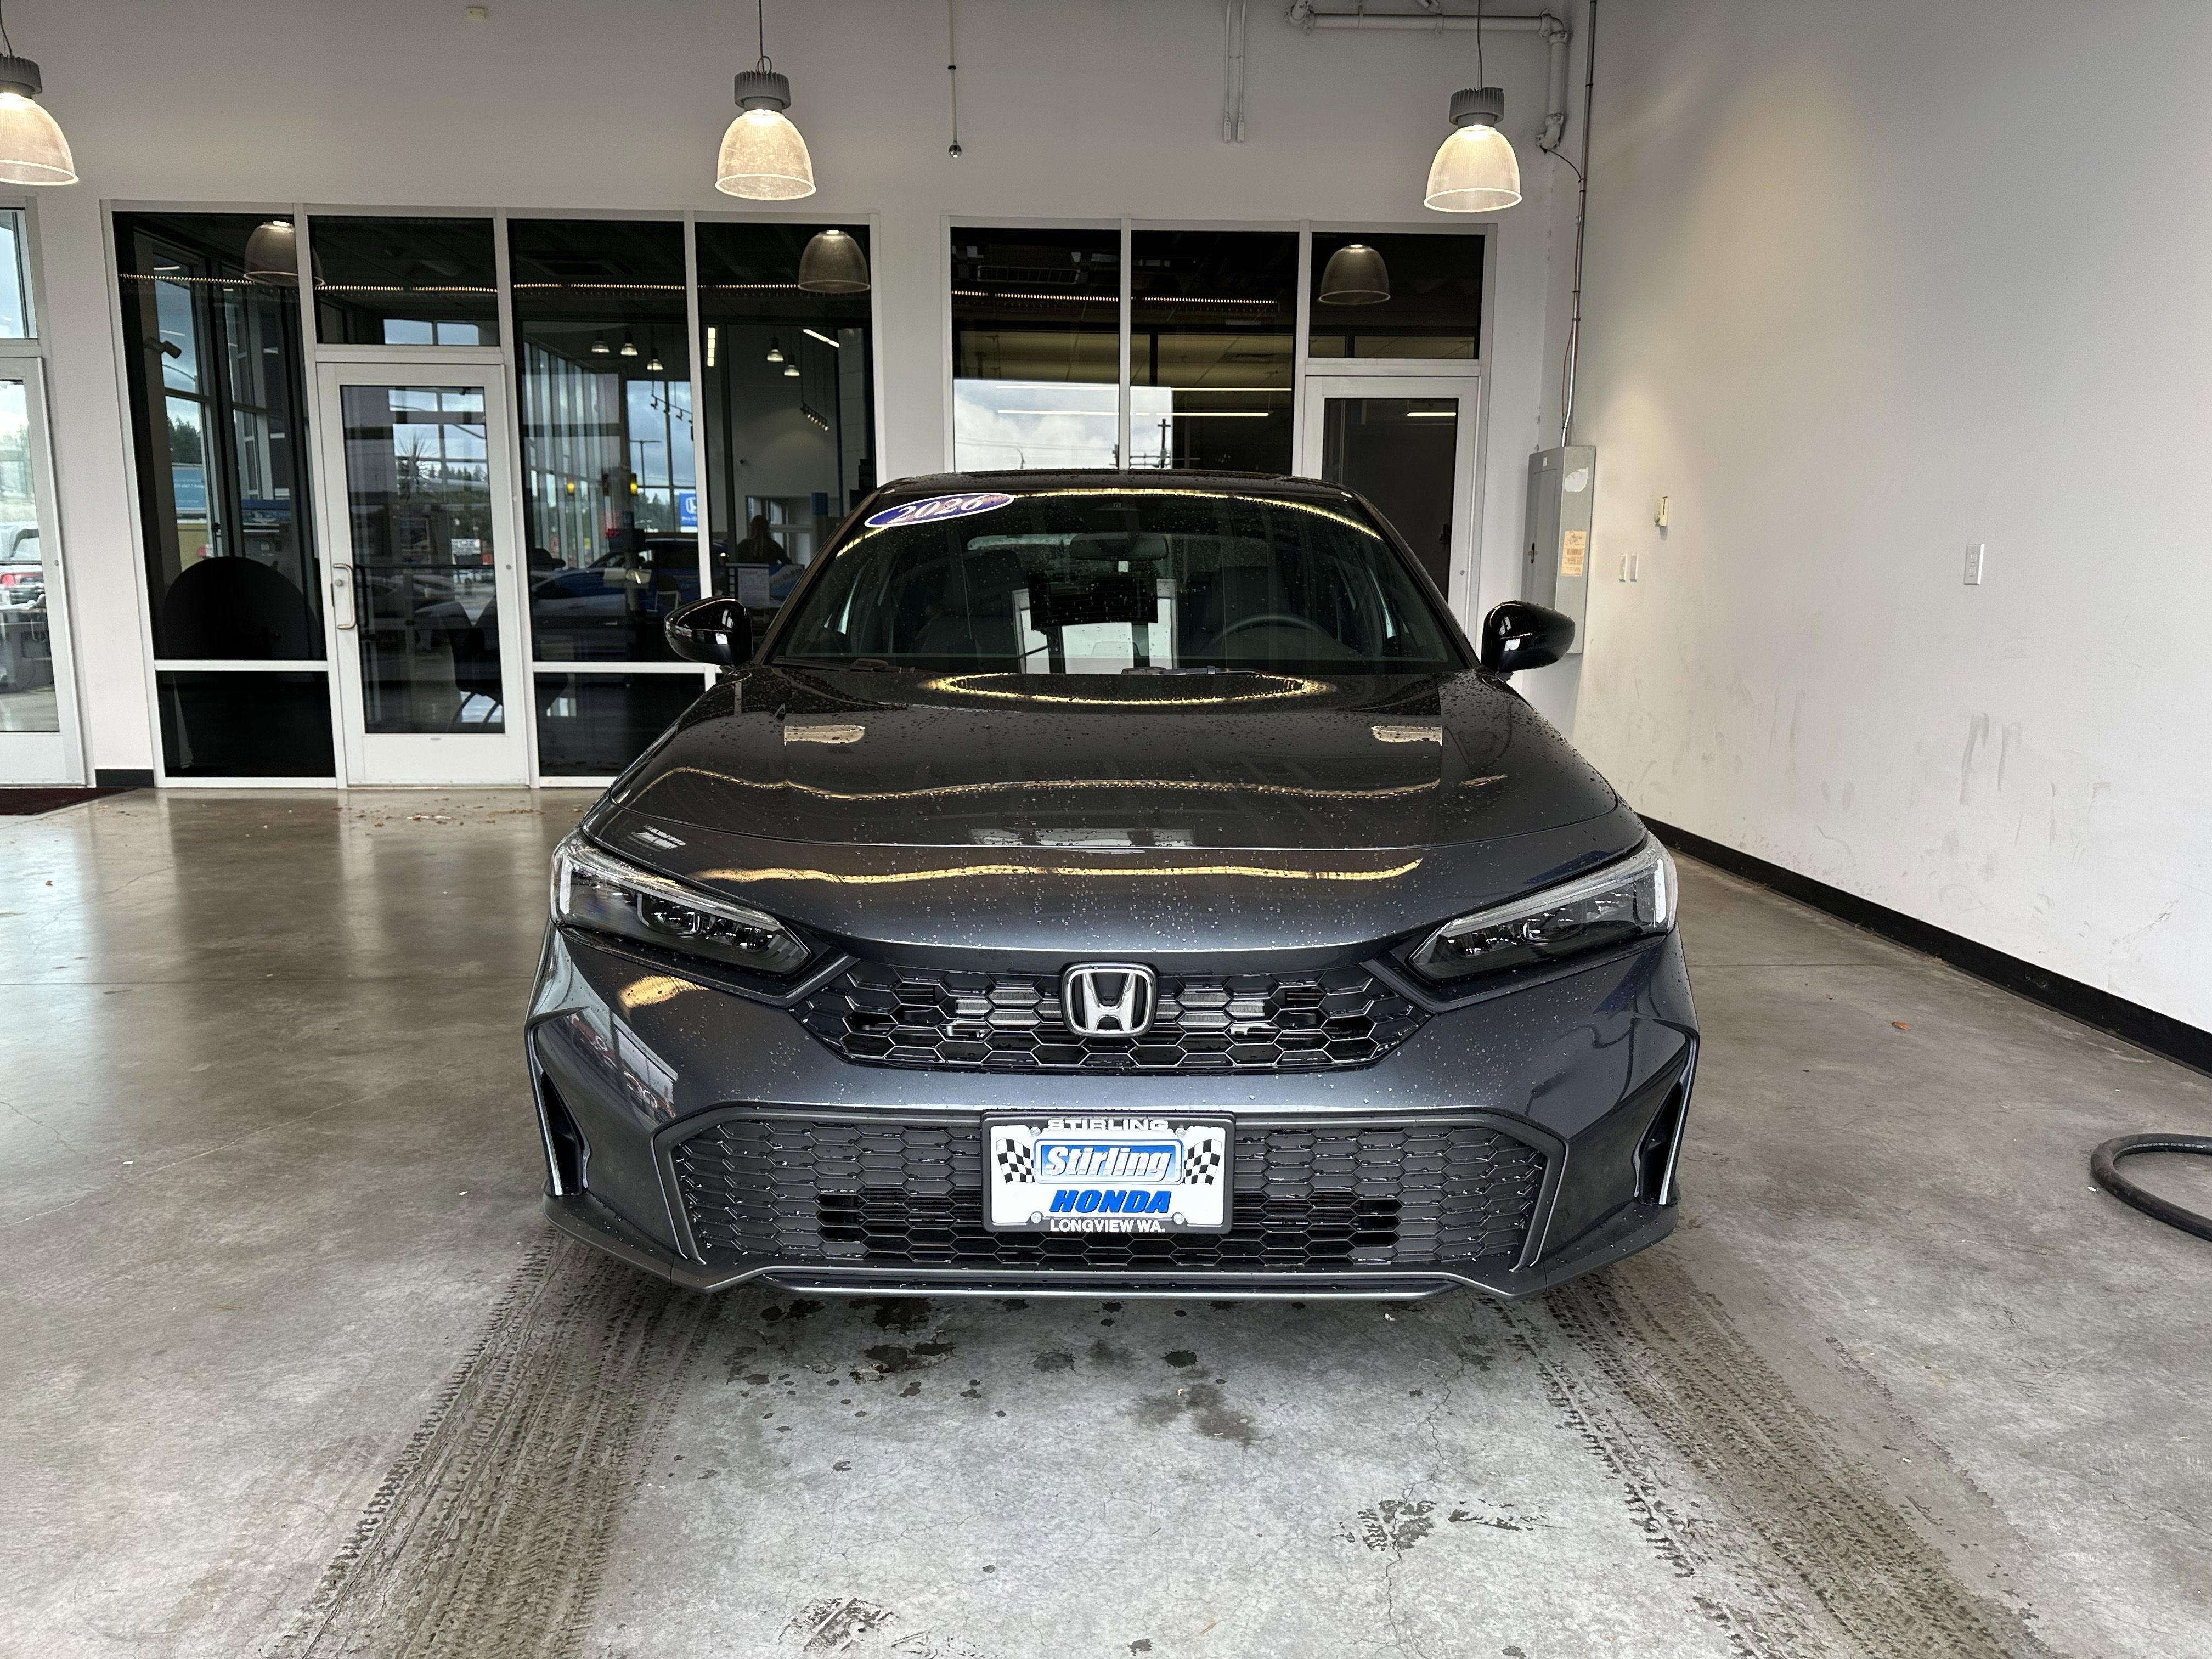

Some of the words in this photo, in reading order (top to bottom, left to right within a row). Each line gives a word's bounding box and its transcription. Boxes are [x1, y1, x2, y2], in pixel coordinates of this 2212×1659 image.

[887, 494, 994, 524] 2026
[1047, 1119, 1169, 1131] STIRLING
[1045, 1146, 1171, 1182] Stirling
[1049, 1189, 1172, 1214] HONDA
[1050, 1219, 1135, 1232] LONGVIEW
[1136, 1220, 1166, 1233] WA.
